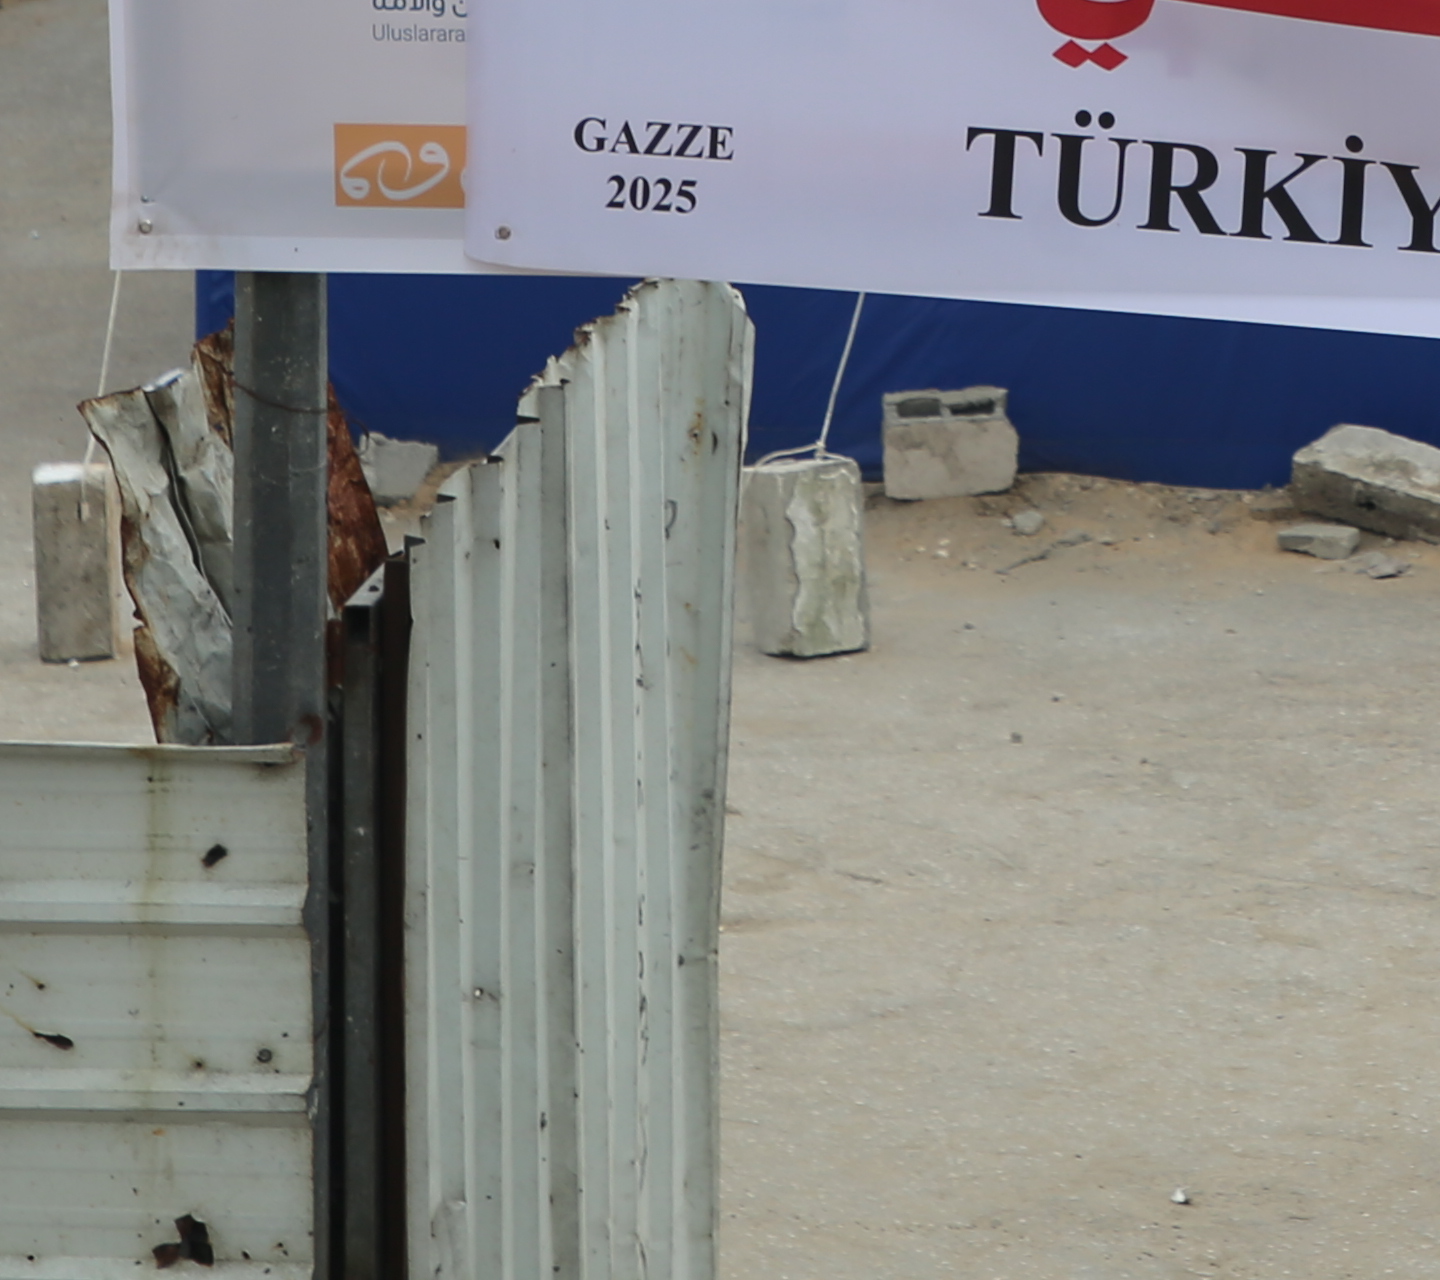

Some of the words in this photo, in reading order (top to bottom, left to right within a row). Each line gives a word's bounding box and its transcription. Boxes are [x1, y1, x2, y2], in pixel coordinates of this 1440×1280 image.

[371, 23, 466, 43] Uluslarara
[573, 117, 735, 160] GAZZE
[606, 175, 698, 212] 2025
